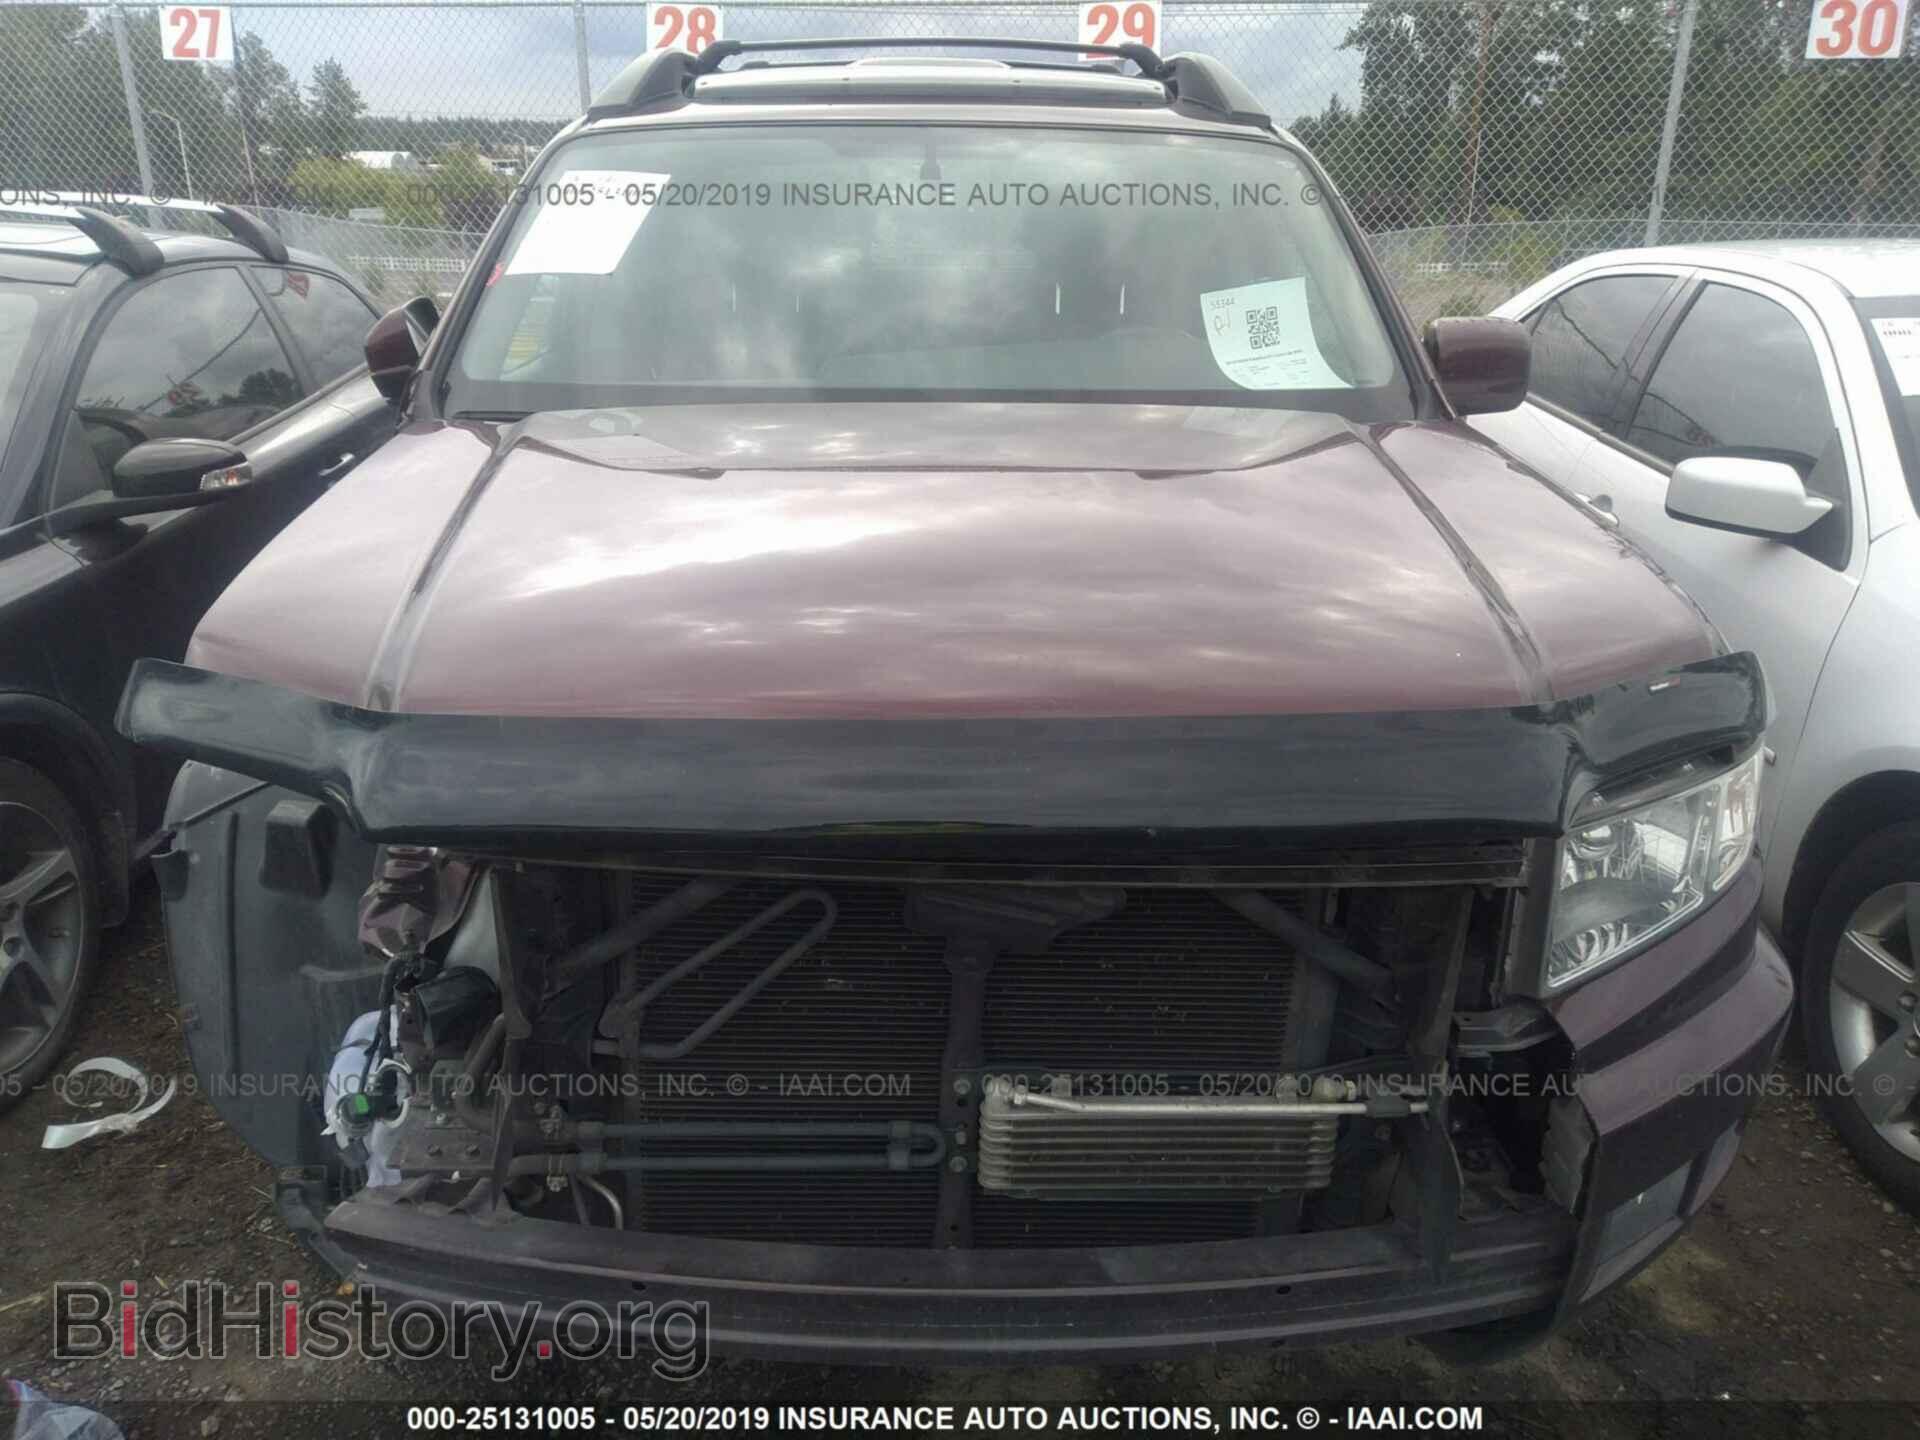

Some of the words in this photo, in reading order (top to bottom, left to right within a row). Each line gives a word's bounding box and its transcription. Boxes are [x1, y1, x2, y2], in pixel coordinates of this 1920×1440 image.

[170, 8, 220, 58] 27
[655, 6, 716, 54] 28
[1087, 3, 1155, 59] 29
[1816, 0, 1898, 57] 30
